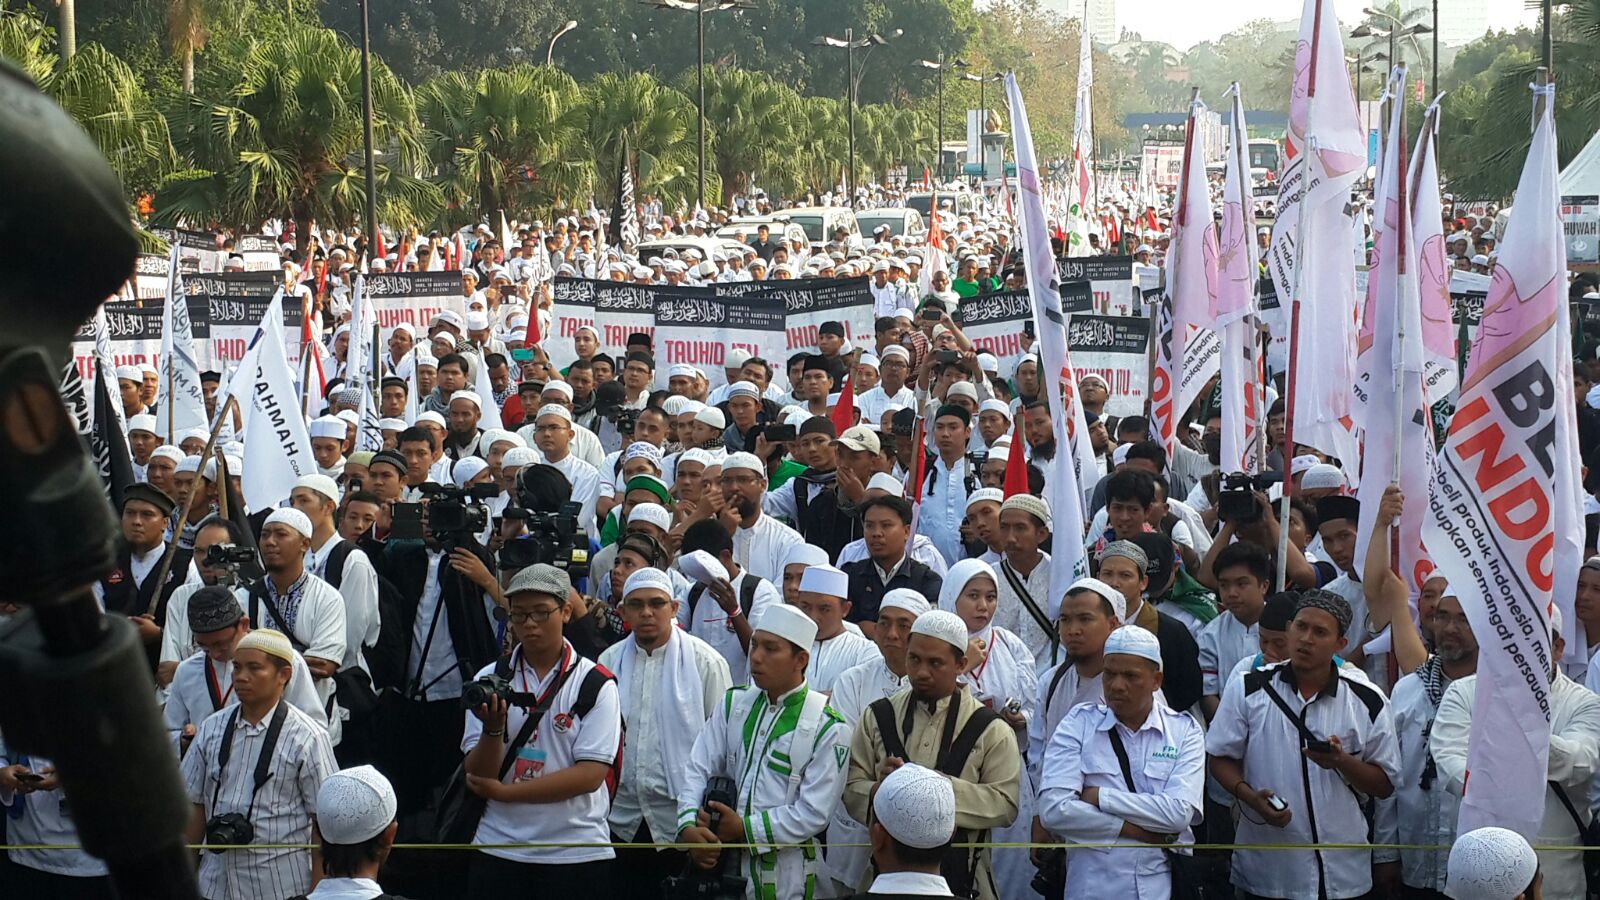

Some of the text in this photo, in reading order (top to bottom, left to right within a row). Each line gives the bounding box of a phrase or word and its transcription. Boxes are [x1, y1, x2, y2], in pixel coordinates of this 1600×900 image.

[1564, 222, 1597, 235] HUWAH
[1273, 246, 1291, 296] semanga
[1281, 241, 1293, 269] Indo
[665, 340, 725, 365] TAUHID
[972, 333, 1020, 357] TAUH
[1450, 396, 1555, 592] INDO
[1453, 499, 1491, 560] produk
[1488, 557, 1535, 642] Indonesia,
[1468, 558, 1515, 641] semangat
